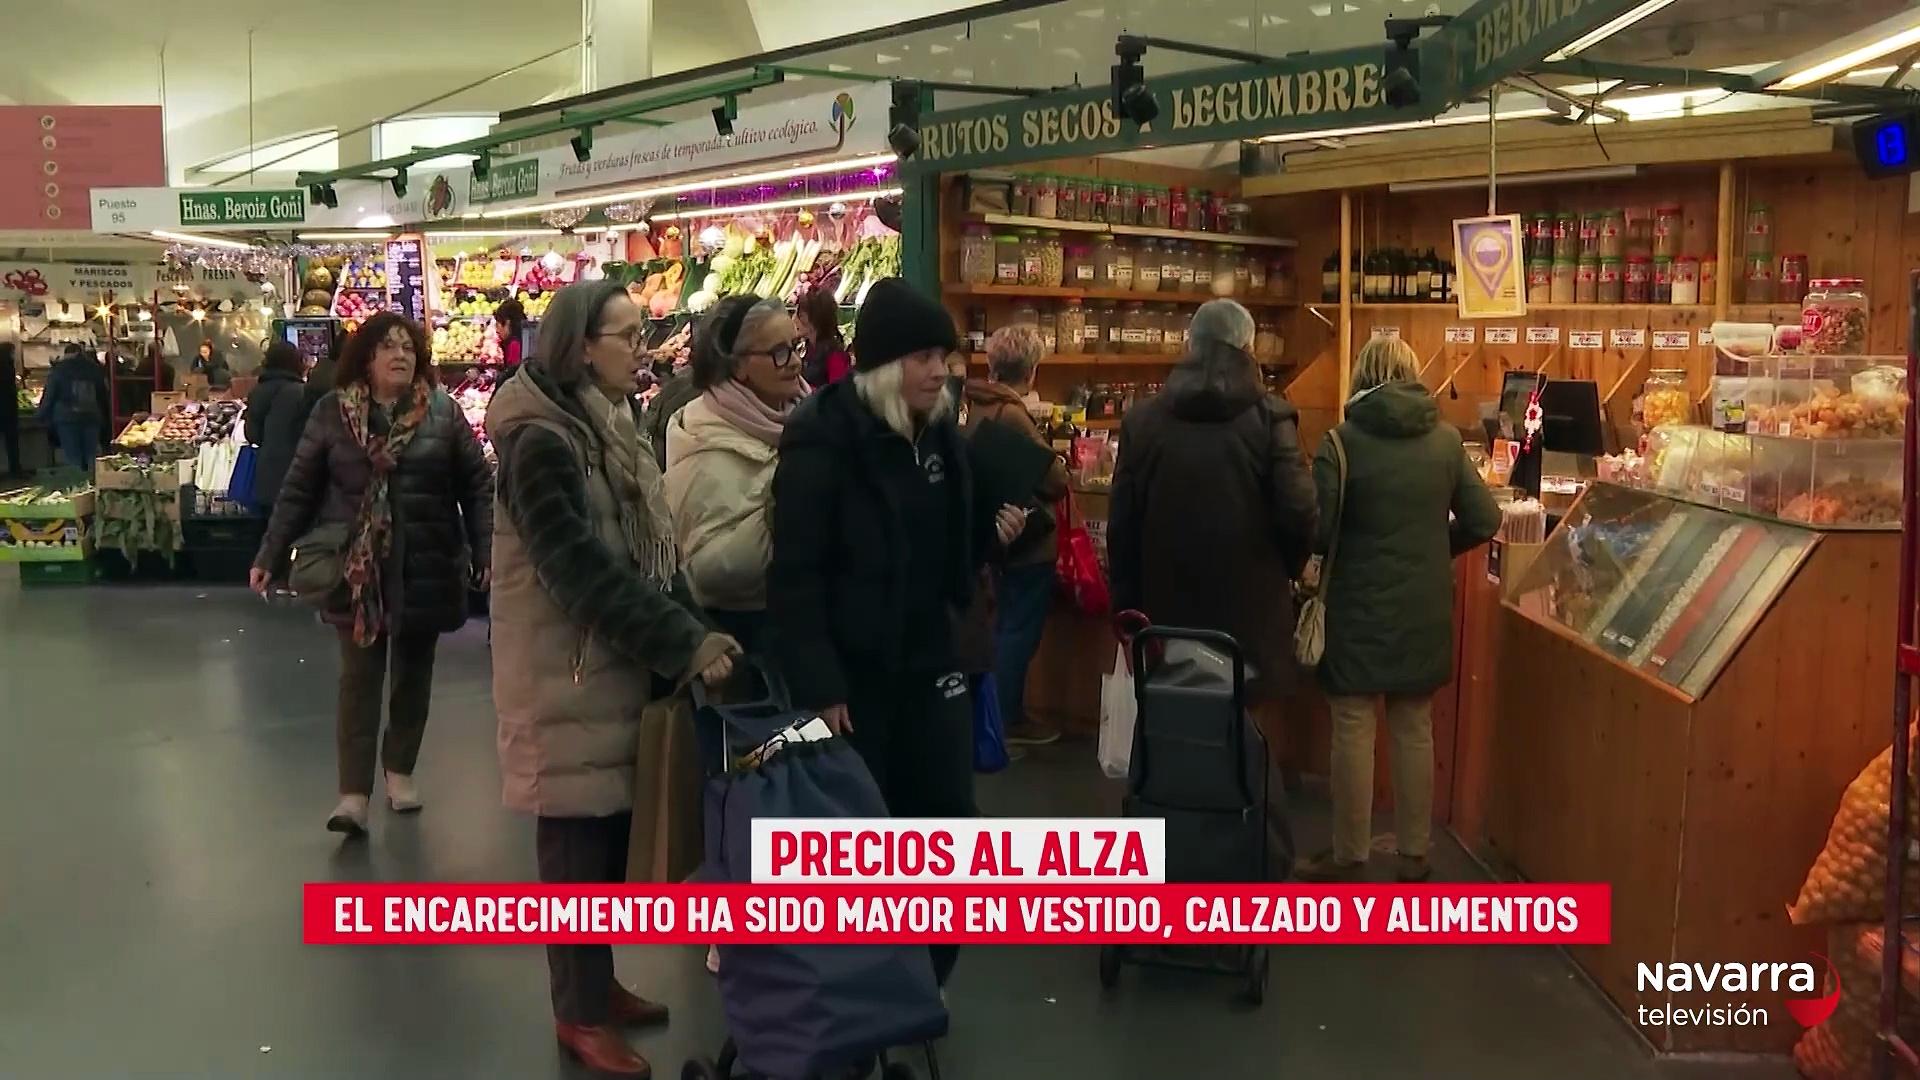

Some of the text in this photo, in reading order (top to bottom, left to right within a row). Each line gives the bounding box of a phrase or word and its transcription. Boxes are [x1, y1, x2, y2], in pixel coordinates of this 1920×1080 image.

[909, 62, 1387, 161] RUTOS SECOS LEGUMBRE
[661, 143, 672, 160] de
[99, 199, 137, 210] Puesto
[182, 195, 303, 220] Hnas. Beroiz Goñi
[74, 267, 127, 276] MARISCOS
[69, 279, 133, 288] Y PESCADOS
